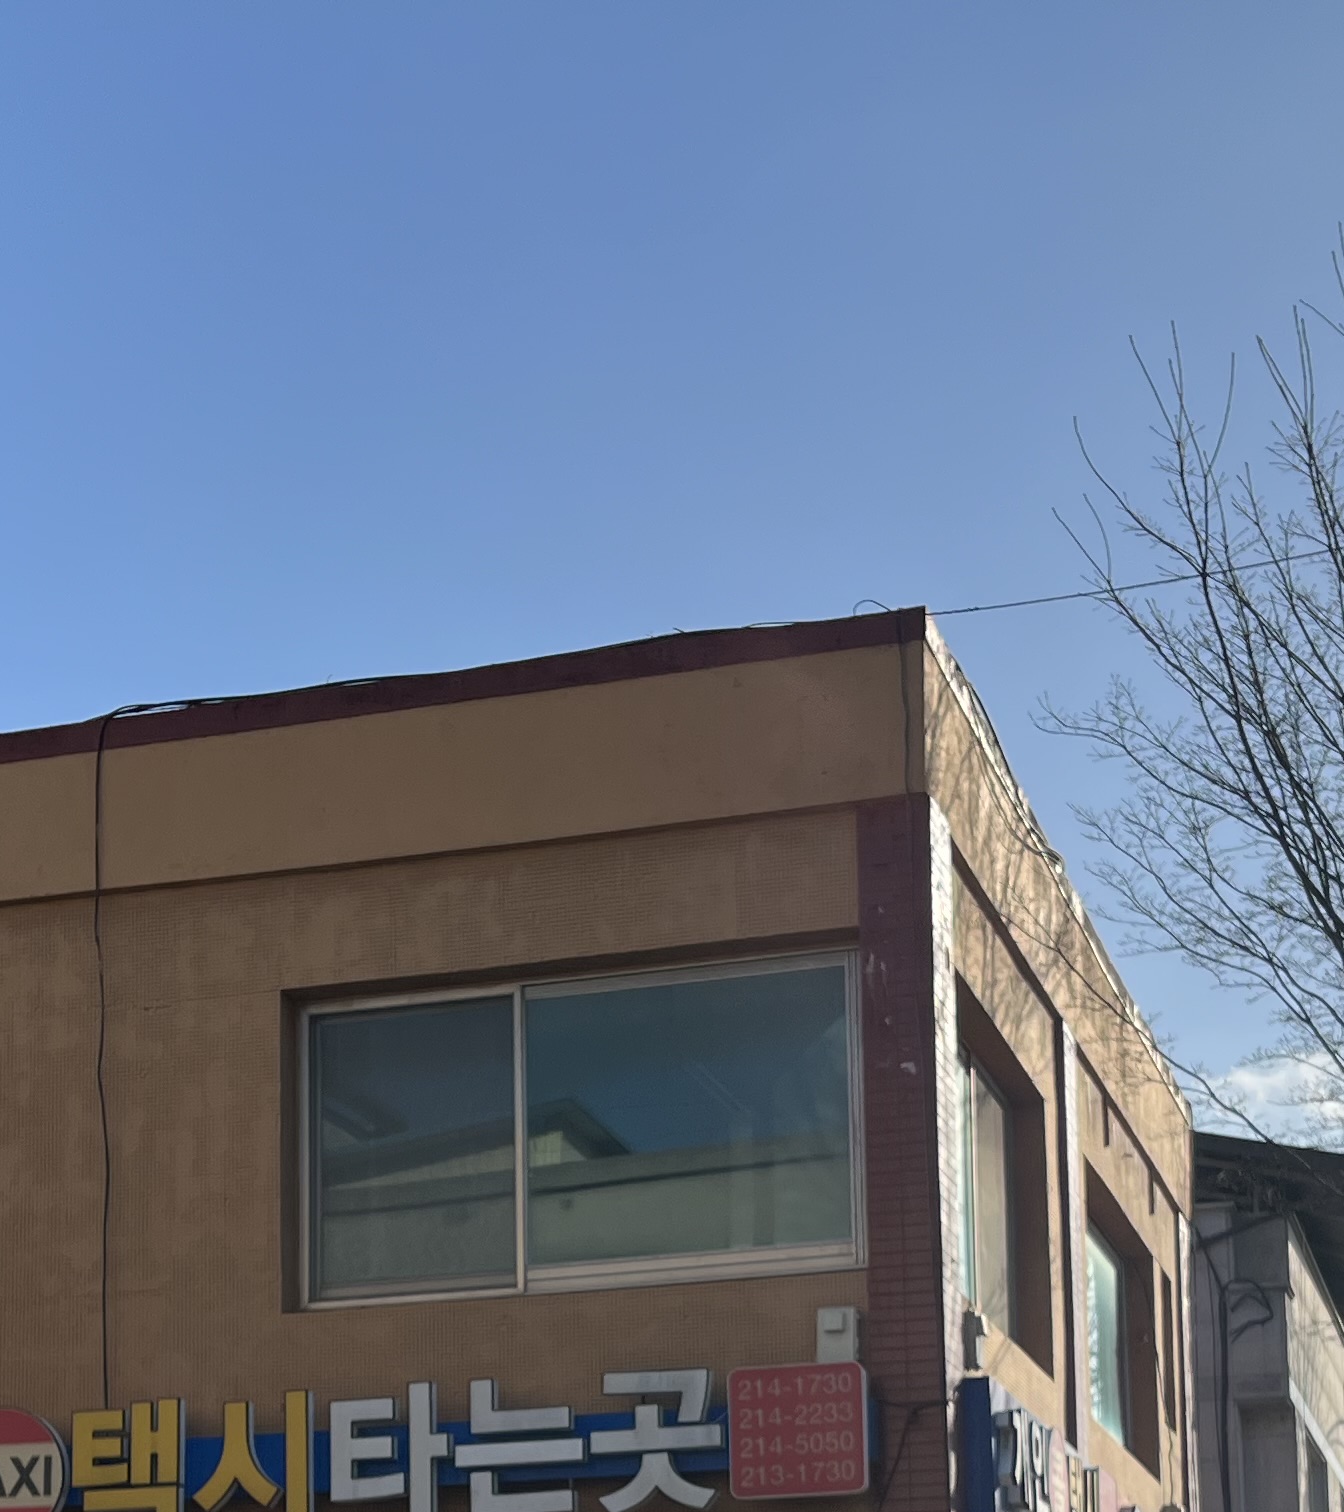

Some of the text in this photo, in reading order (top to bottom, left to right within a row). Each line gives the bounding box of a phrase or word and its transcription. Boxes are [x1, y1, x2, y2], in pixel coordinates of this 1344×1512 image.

[737, 1372, 852, 1400] 214-1730
[739, 1401, 853, 1429] 214-2233
[740, 1430, 854, 1458] 214-5050
[740, 1459, 855, 1488] 213-1730
